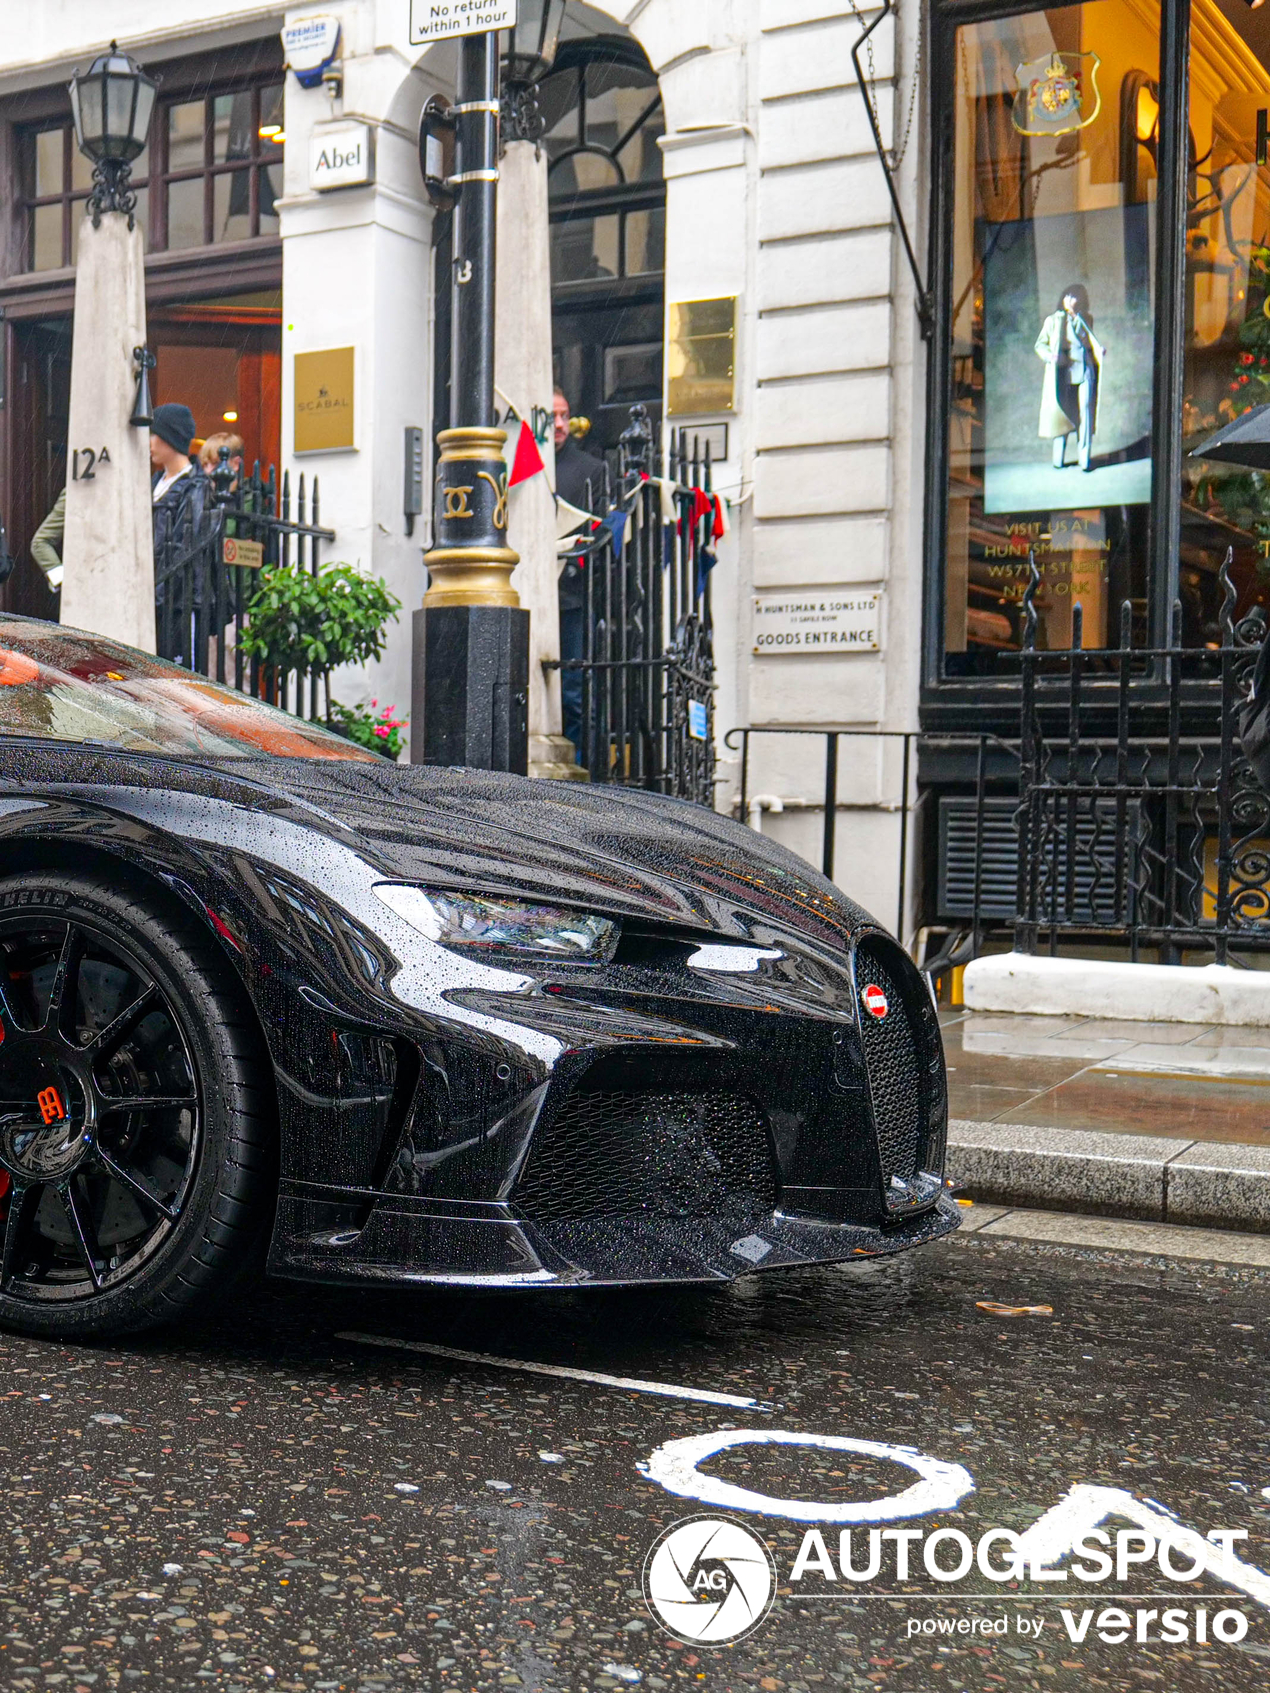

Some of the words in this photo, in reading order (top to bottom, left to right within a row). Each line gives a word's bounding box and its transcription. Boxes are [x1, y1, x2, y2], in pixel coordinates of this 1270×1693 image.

[430, 6, 449, 17] No
[455, 0, 497, 14] return
[419, 19, 460, 35] within
[466, 15, 471, 26] 1
[476, 11, 508, 25] hour
[315, 143, 361, 171] Abel
[298, 398, 349, 412] SCABAL
[72, 446, 111, 481] 12A
[1005, 521, 1042, 535] VISIT
[1047, 520, 1068, 534] US
[1071, 520, 1090, 532] AT
[984, 541, 1075, 558] HUNTSMAN
[1050, 559, 1106, 575] STREET
[1046, 581, 1090, 596] YORK
[756, 606, 762, 614] H
[765, 604, 816, 613] HUNTSMAN
[819, 603, 826, 612] &
[830, 602, 855, 611] SONS
[858, 601, 875, 610] LTD
[757, 632, 801, 645] GOODS
[805, 630, 874, 644] ENTRANCE
